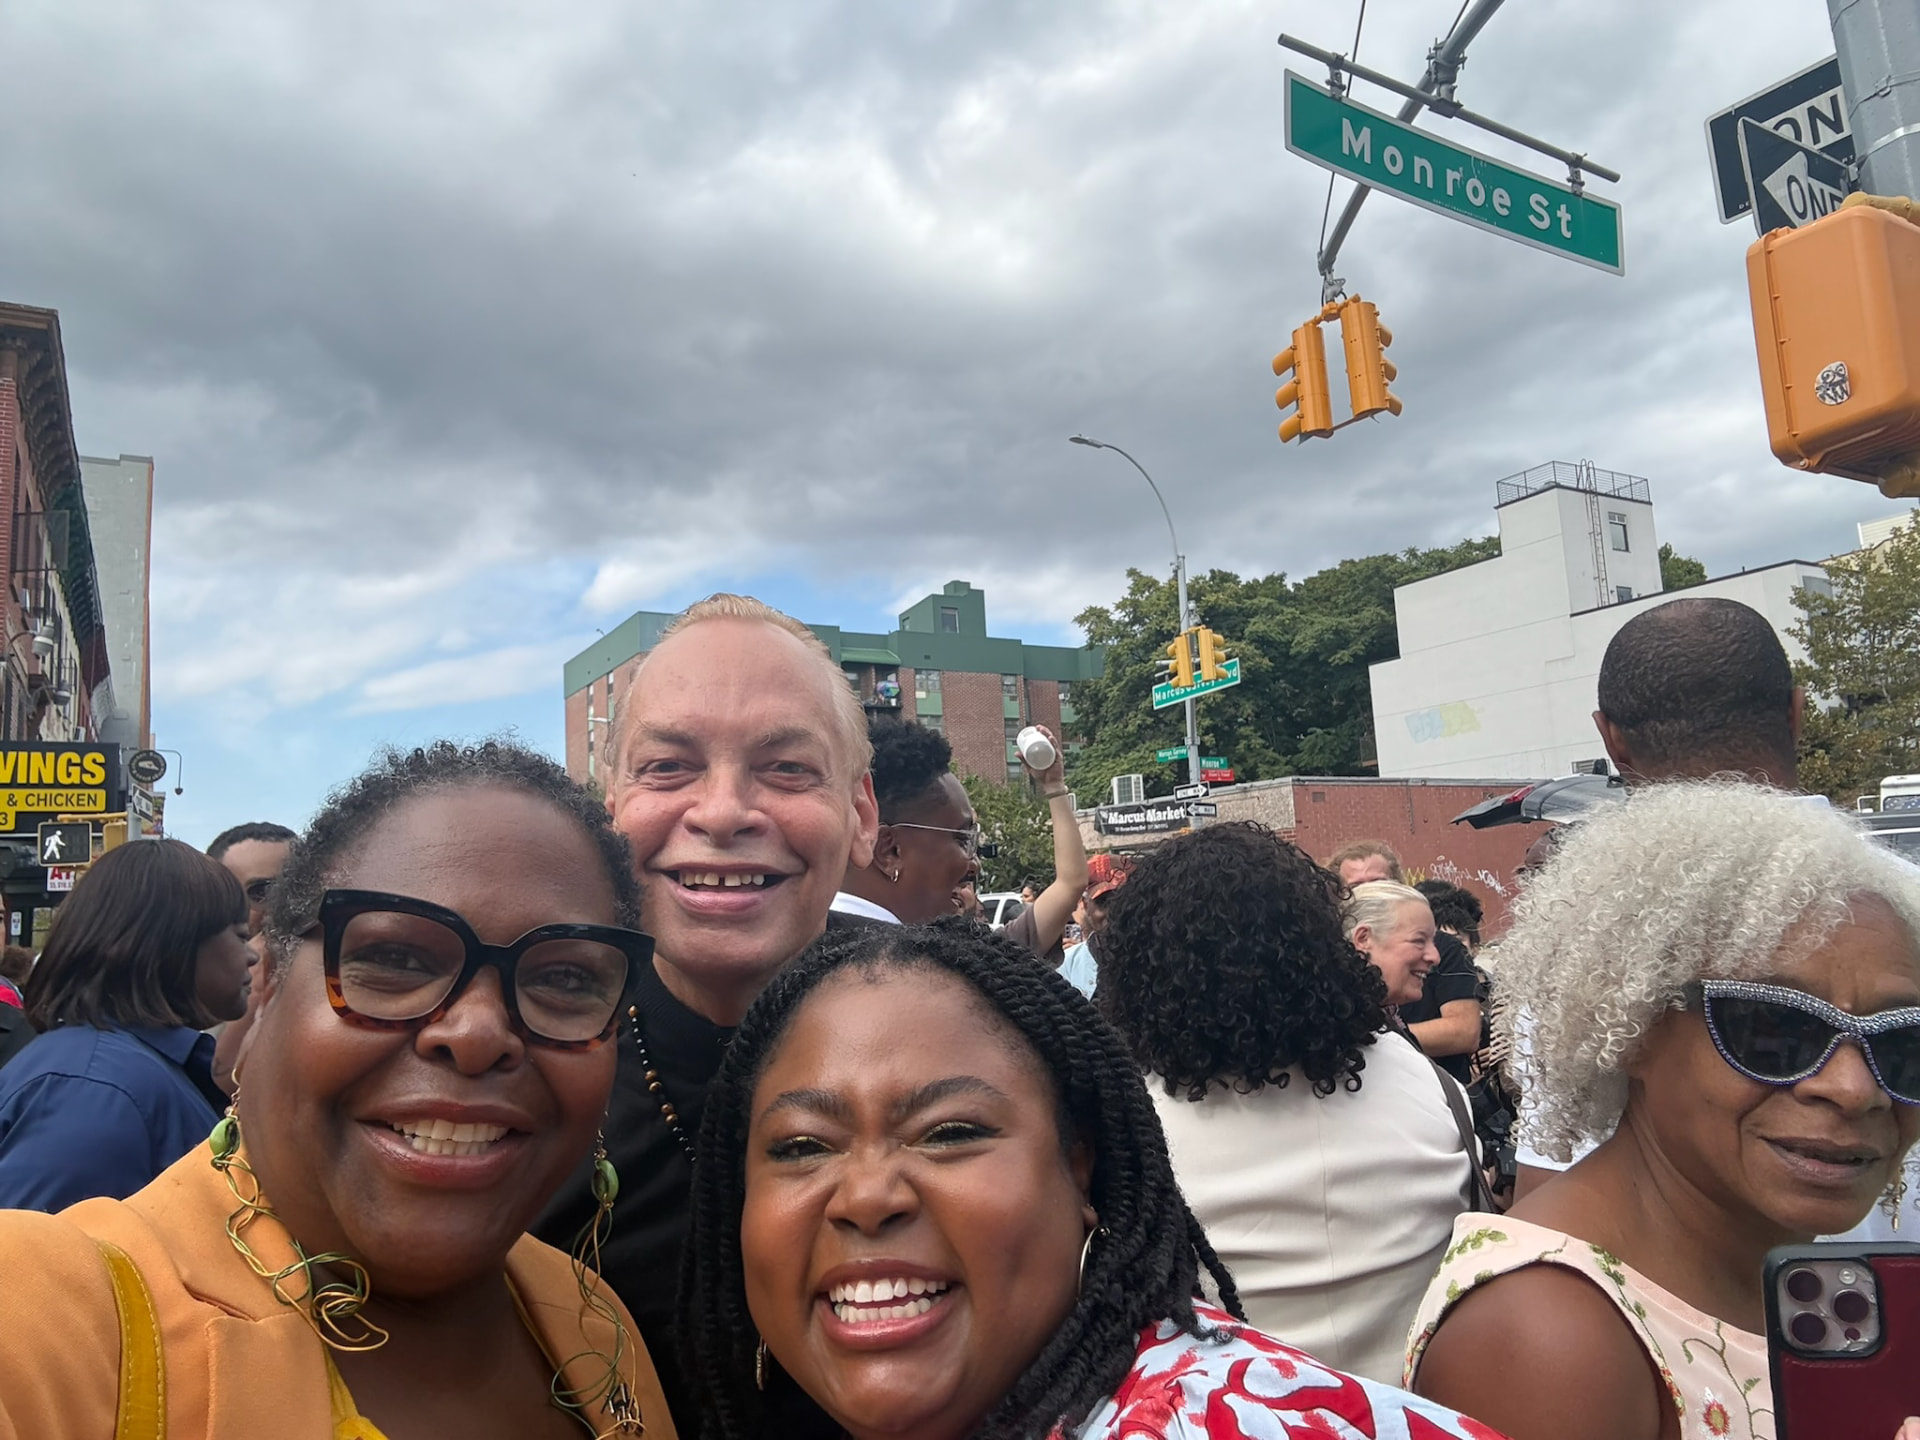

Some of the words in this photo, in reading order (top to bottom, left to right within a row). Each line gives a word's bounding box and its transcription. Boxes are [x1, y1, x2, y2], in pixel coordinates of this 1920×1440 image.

[1342, 118, 1512, 216] Monroe
[1528, 193, 1572, 239] St
[7, 793, 17, 807] &
[25, 792, 97, 807] CHICKEN
[1108, 811, 1145, 825] Marcus
[1146, 806, 1186, 823] Market
